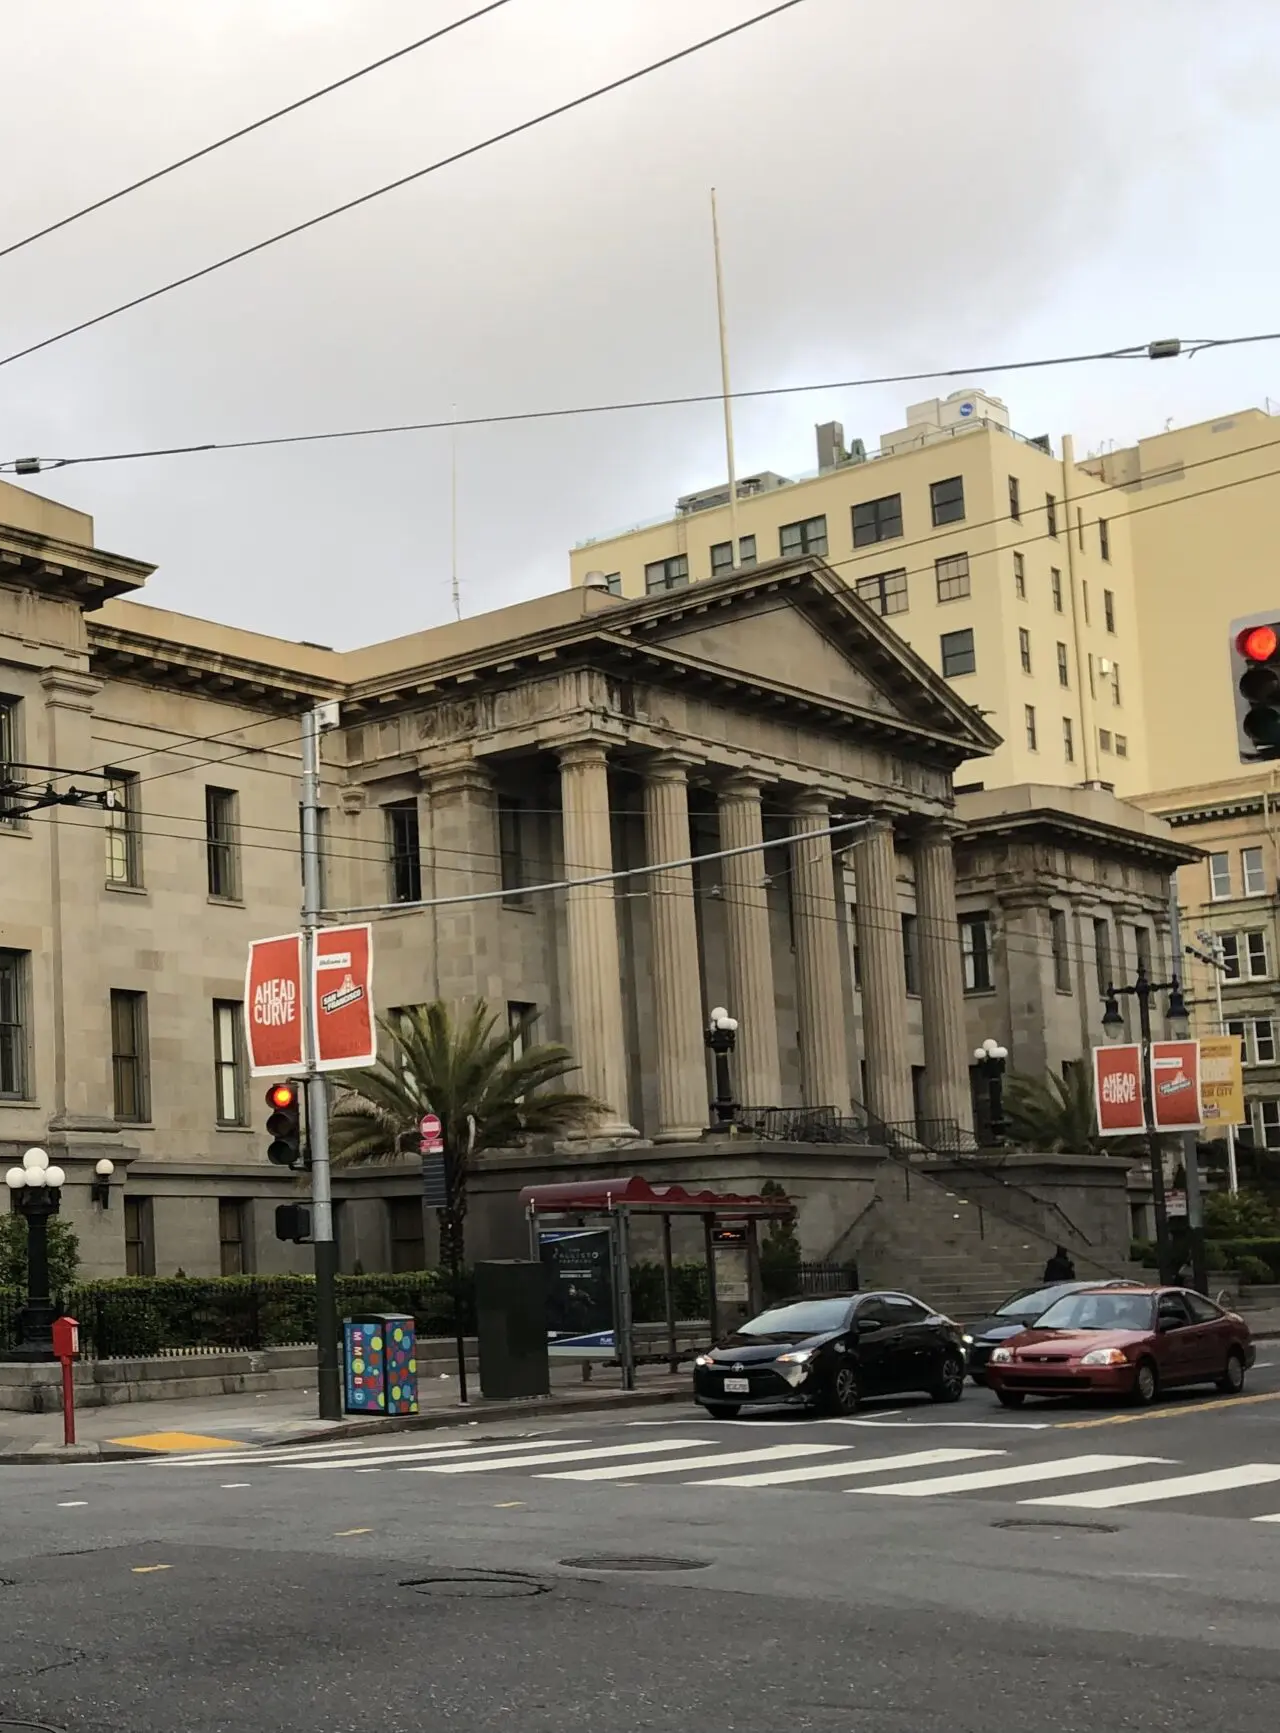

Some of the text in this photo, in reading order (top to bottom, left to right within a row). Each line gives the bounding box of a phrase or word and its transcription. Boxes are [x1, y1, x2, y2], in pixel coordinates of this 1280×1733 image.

[254, 977, 296, 1005] AHEAD
[323, 993, 337, 1005] SAN
[253, 999, 296, 1027] CURVE
[1102, 1071, 1136, 1090] AHEAD
[1102, 1085, 1137, 1105] CURVE
